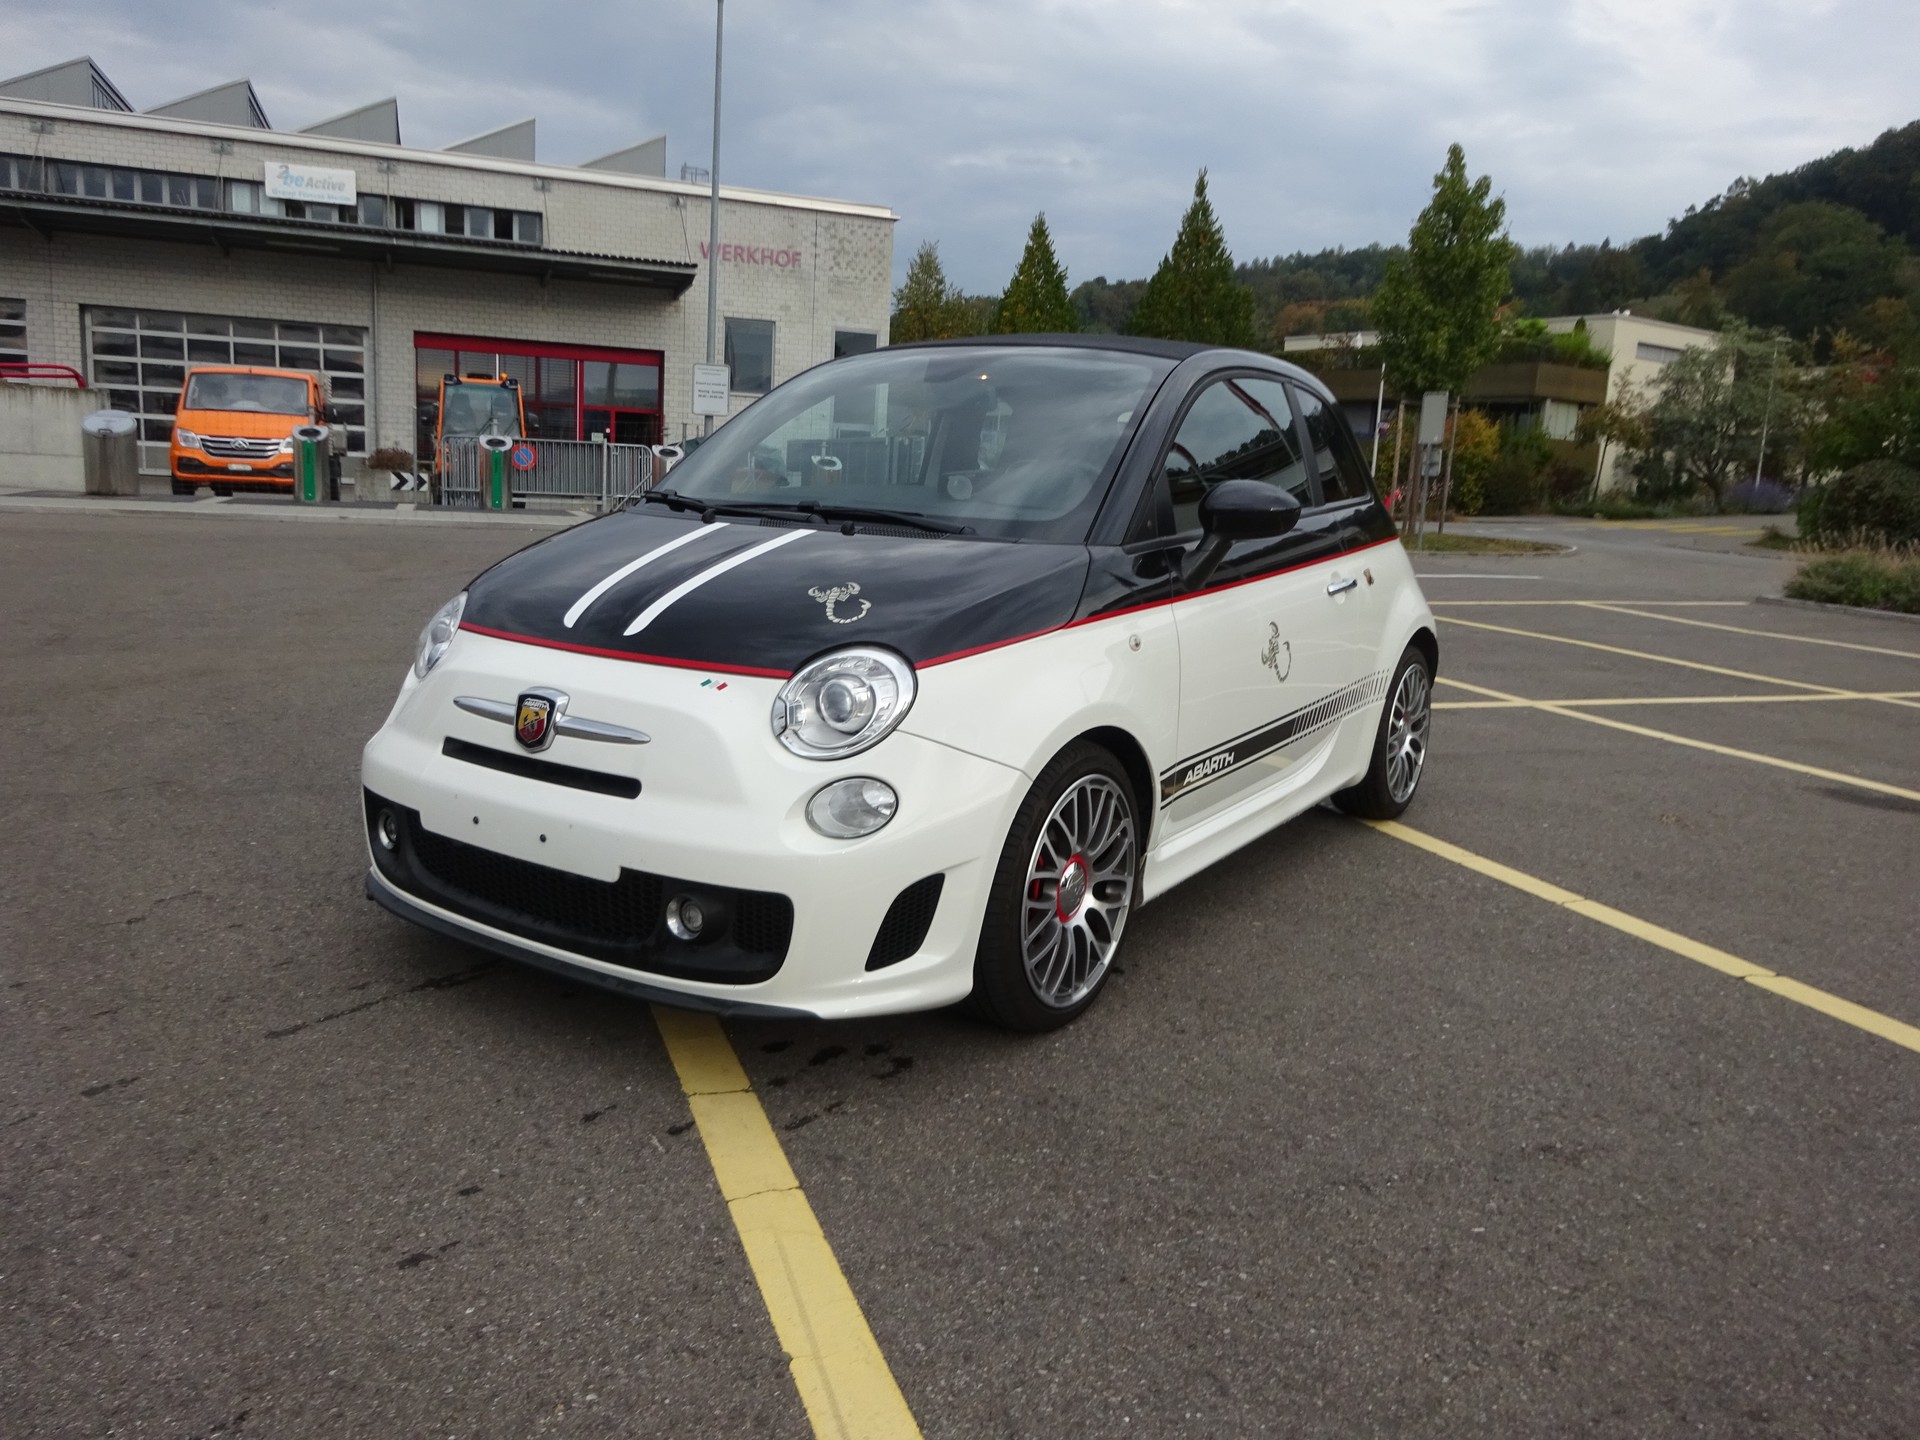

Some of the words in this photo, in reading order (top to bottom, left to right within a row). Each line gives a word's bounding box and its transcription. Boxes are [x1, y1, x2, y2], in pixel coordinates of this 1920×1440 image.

[305, 175, 346, 192] Active
[700, 241, 802, 269] WERKHOF
[1183, 751, 1235, 786] ABARTH
